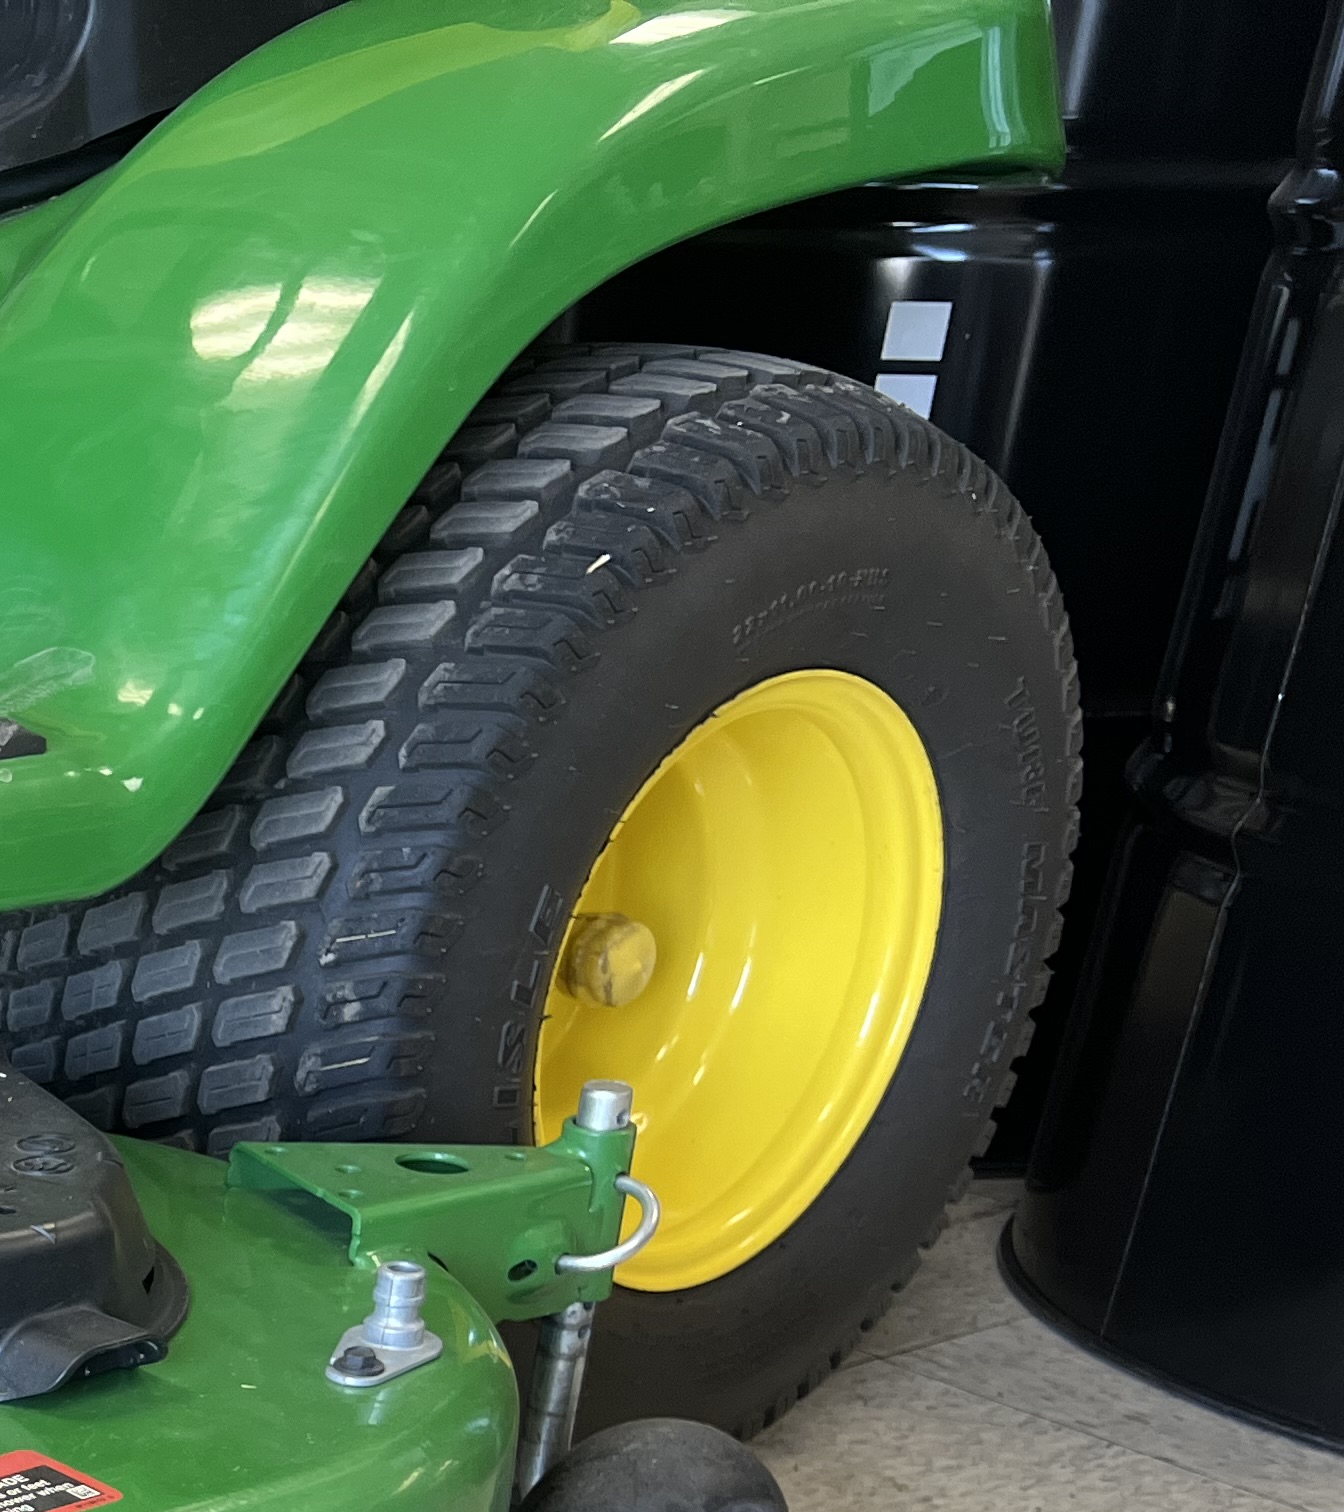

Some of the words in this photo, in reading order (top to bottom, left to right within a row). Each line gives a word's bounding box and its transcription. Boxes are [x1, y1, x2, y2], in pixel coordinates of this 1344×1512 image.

[6, 1487, 22, 1496] or
[20, 1479, 51, 1491] feet
[36, 1482, 74, 1496] when
